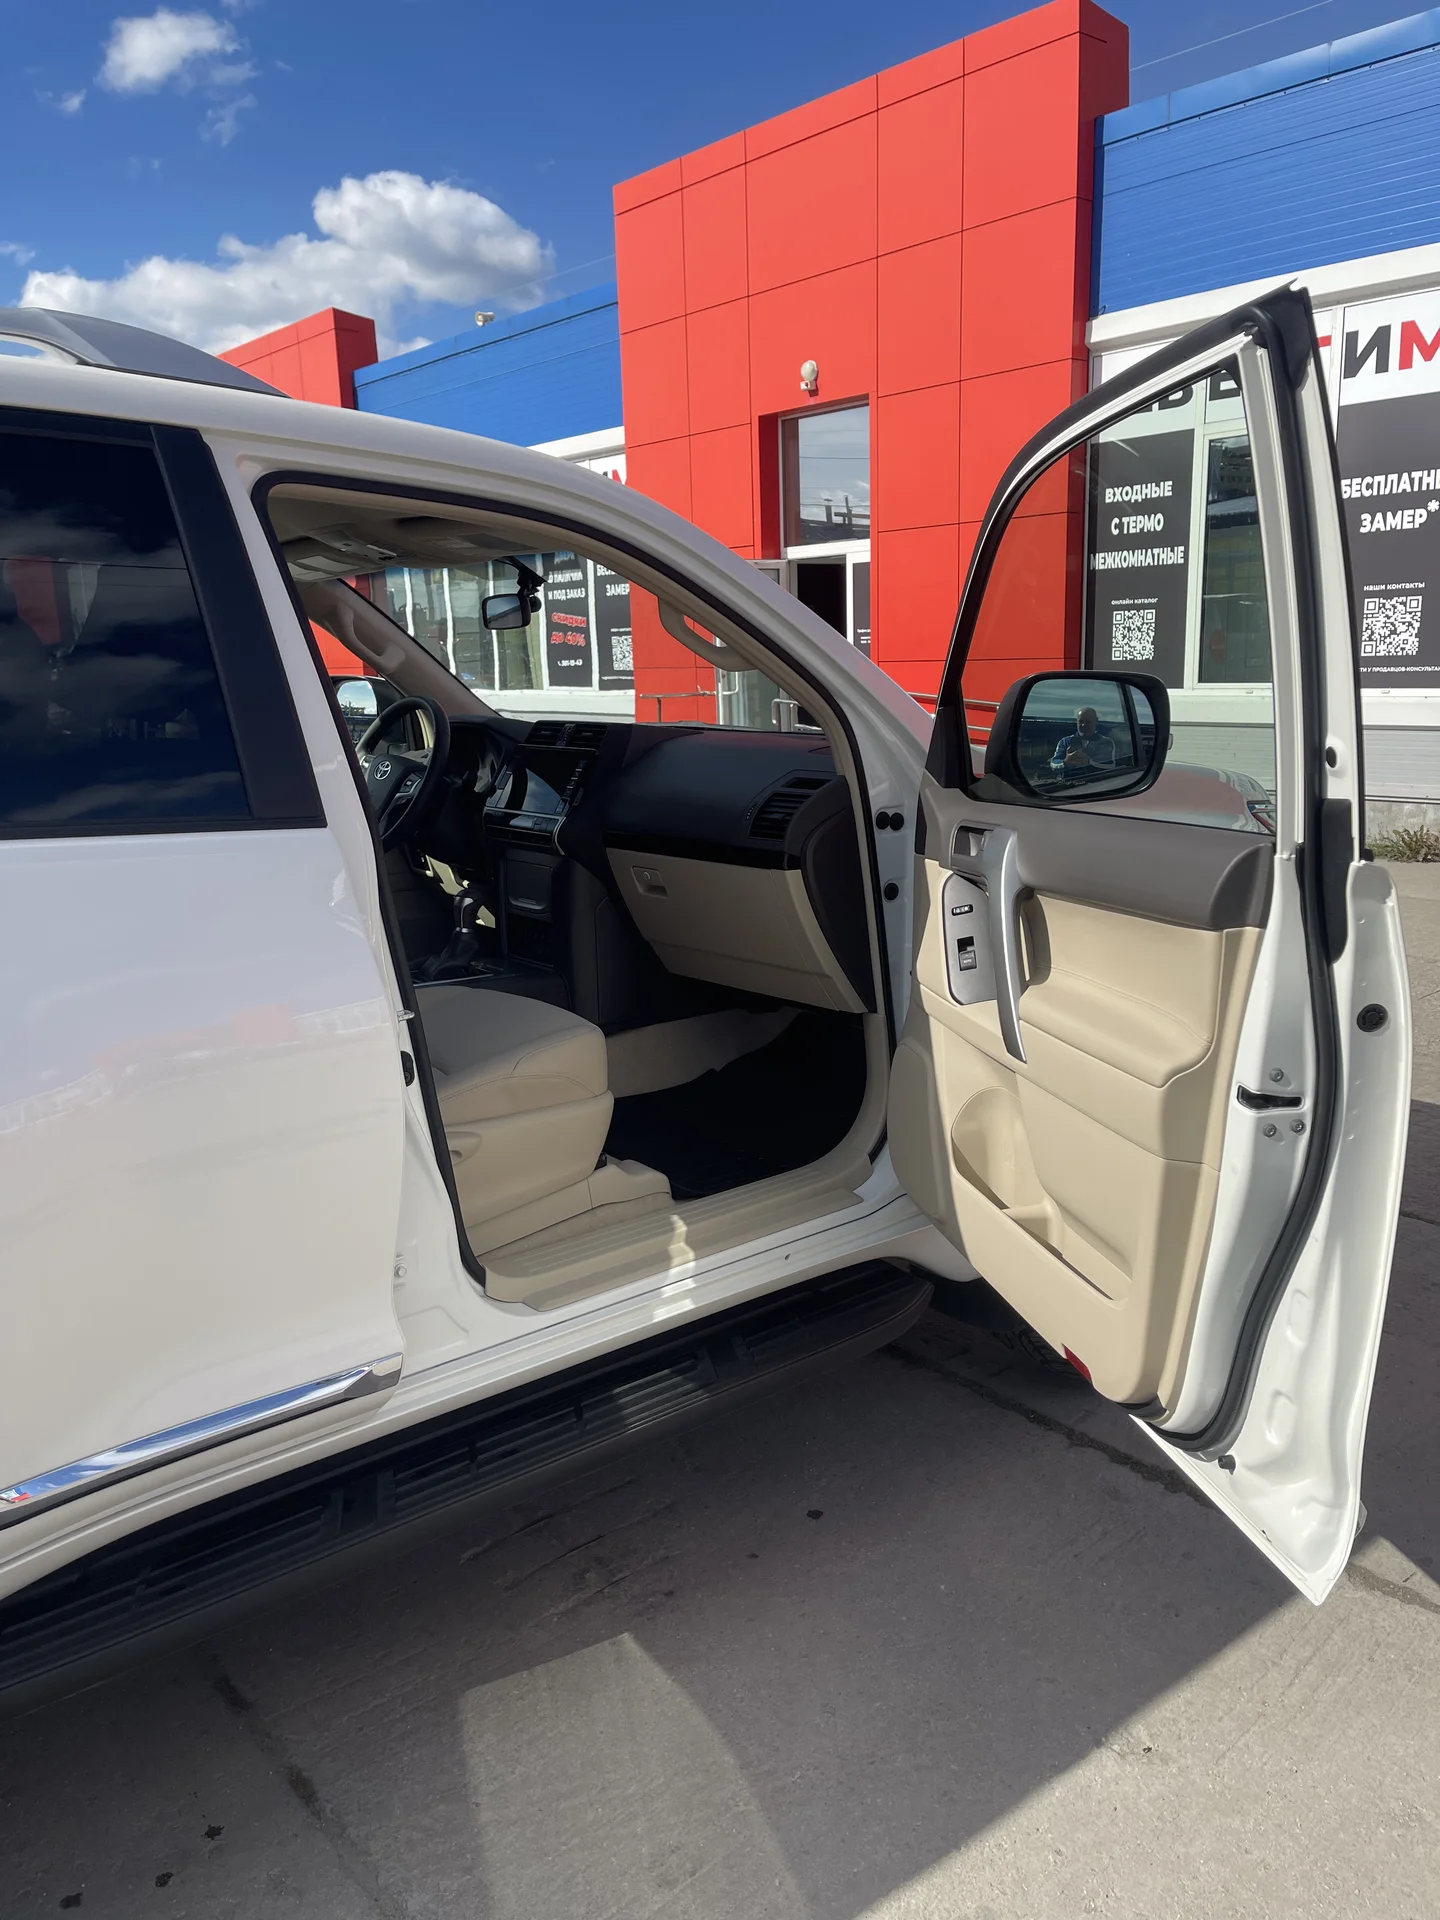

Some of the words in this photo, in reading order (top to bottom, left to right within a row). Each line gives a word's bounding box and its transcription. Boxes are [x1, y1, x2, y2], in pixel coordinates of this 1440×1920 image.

[1105, 480, 1173, 503] ВХОДНЫЕ
[1111, 517, 1120, 535] С
[1122, 512, 1164, 534] ТЕРМО
[1090, 545, 1185, 570] МЕЖКОМНАТНЫЕ
[1387, 581, 1425, 591] контакты
[1111, 598, 1133, 606] онлайн
[1134, 597, 1159, 605] каталог
